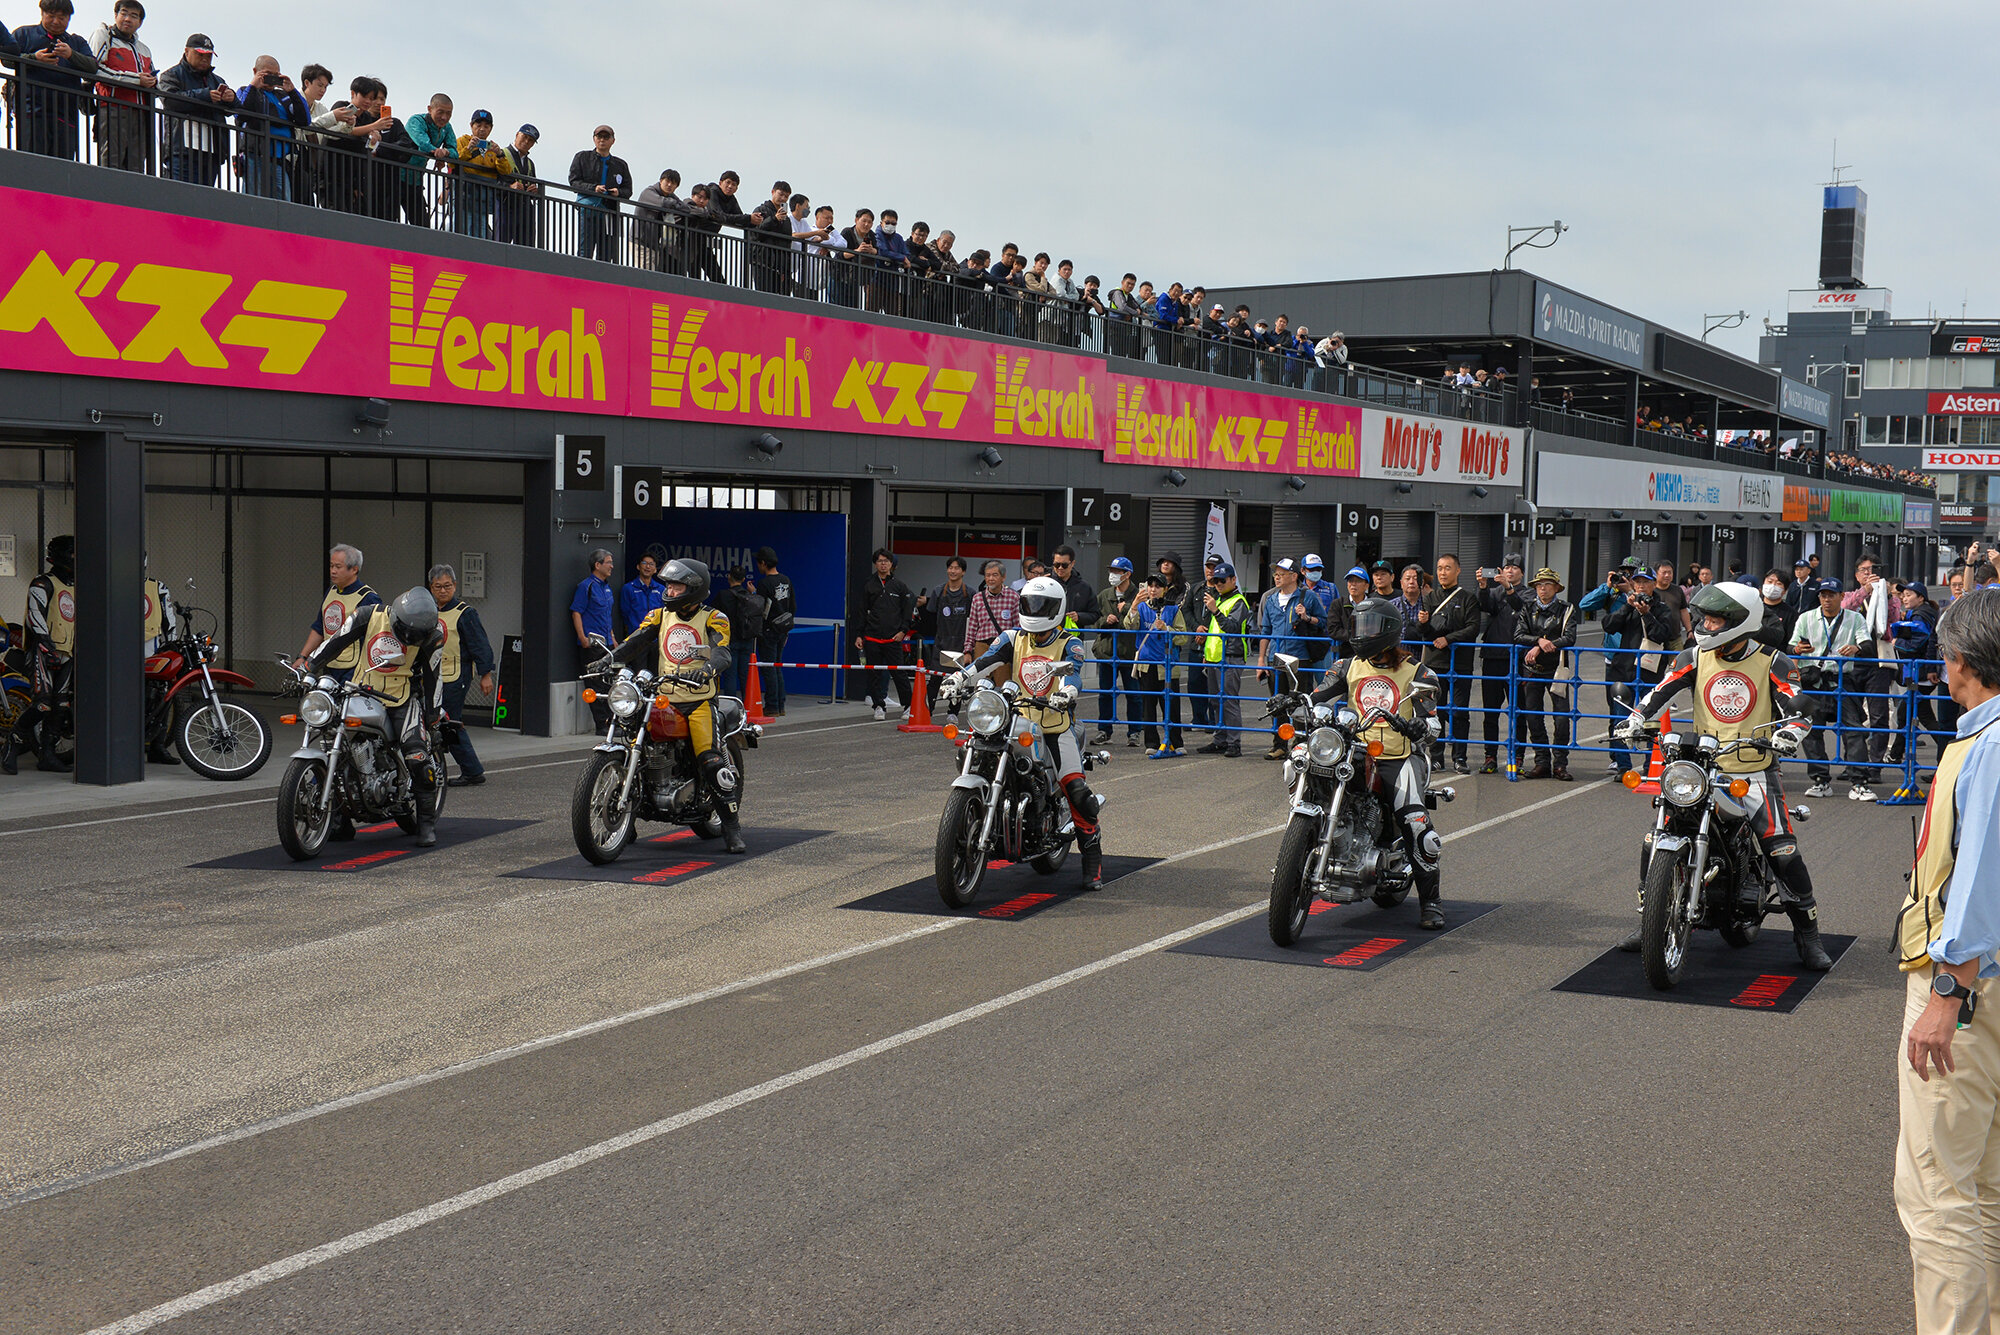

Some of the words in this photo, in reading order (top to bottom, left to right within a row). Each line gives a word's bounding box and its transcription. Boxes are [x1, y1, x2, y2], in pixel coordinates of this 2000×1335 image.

[1818, 293, 1857, 303] KYB
[0, 250, 347, 375] ベスラ
[1554, 304, 1586, 337] MAZDA
[1587, 316, 1612, 345] SPIRIT
[1613, 326, 1640, 355] RACING
[833, 357, 977, 430] ベスラ
[1209, 415, 1289, 465] ベスラ
[1381, 416, 1443, 476] Moty's
[576, 449, 592, 477] 5
[1459, 425, 1510, 480] Moty's
[1928, 453, 2000, 465] HOND
[634, 480, 650, 507] 6
[1655, 472, 1683, 503] NISHIO
[1081, 498, 1095, 517] 7
[1109, 502, 1122, 521] 8
[1348, 511, 1359, 526] 9
[1510, 519, 1526, 532] 11
[1538, 523, 1554, 535] 12
[1636, 524, 1651, 536] 13
[1716, 528, 1729, 538] 15
[1778, 531, 1790, 540] 17
[669, 545, 755, 573] YAMAHA
